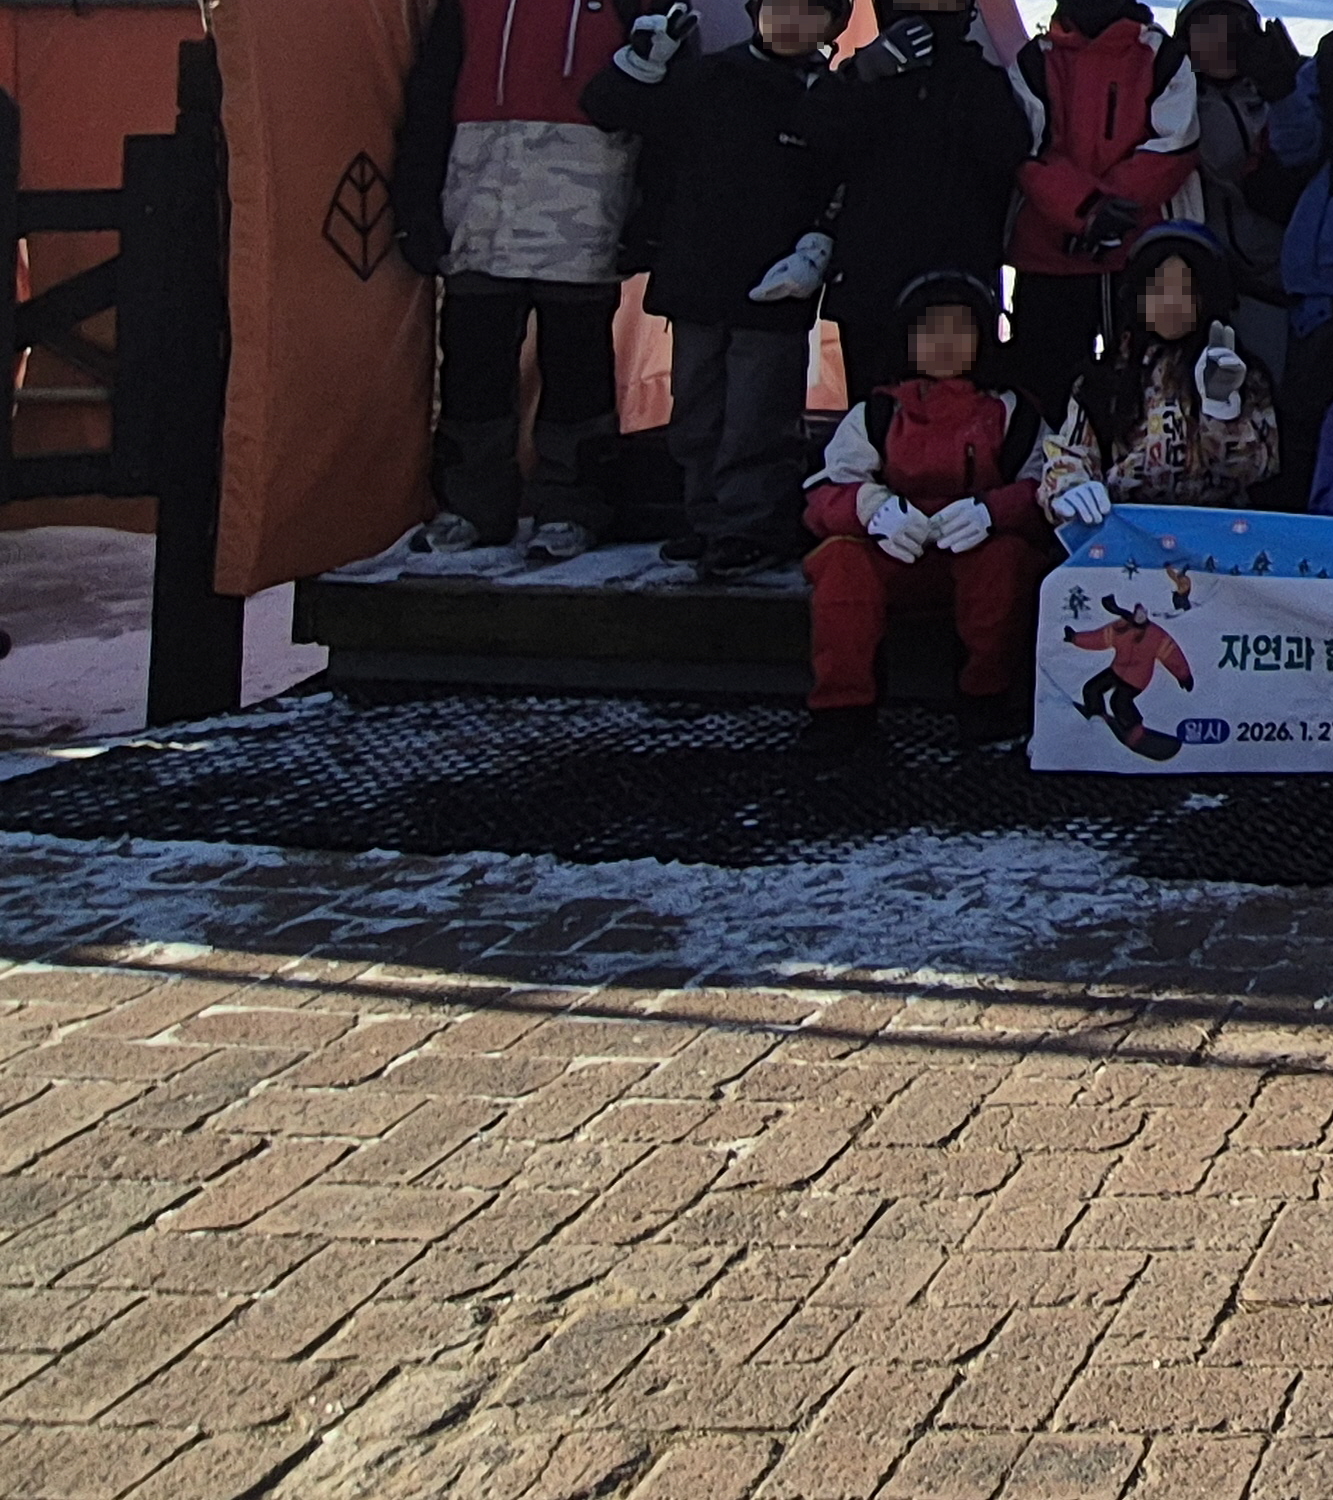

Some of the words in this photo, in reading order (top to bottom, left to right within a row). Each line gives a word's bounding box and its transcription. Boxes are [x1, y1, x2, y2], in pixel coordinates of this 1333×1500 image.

[1217, 633, 1315, 672] 자연과
[1183, 720, 1224, 743] 일시
[1236, 722, 1294, 742] 2026.
[1299, 722, 1313, 742] 1.
